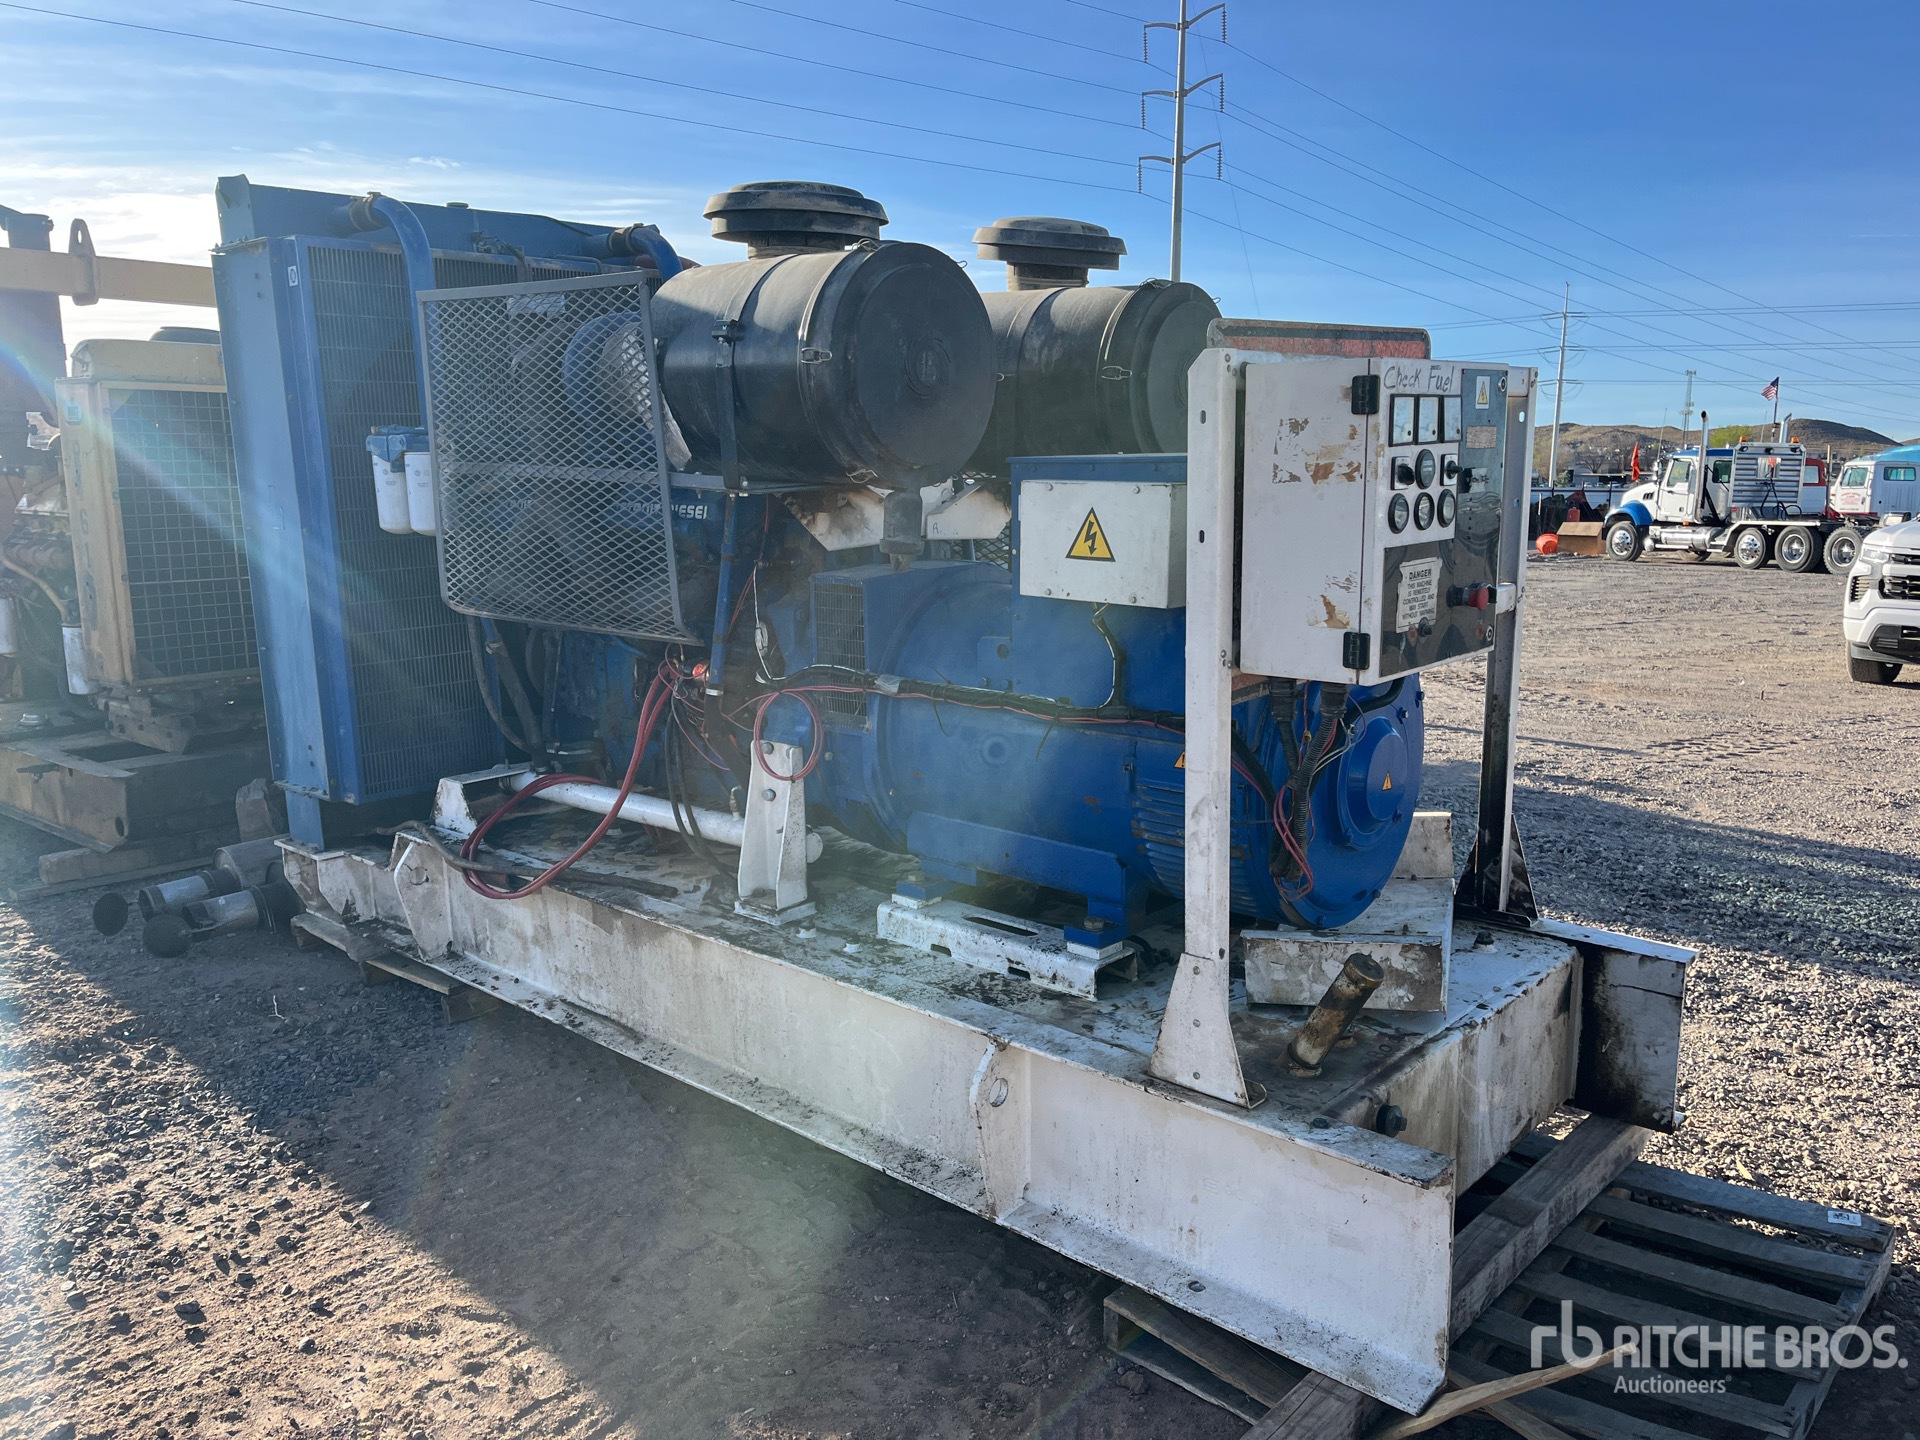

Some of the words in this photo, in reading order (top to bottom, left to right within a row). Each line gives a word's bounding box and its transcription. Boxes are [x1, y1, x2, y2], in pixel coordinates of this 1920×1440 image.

[1383, 365, 1421, 388] Check
[1427, 365, 1455, 392] Fuel
[1409, 569, 1432, 579] DANGER
[1416, 580, 1432, 588] MACHINE
[1413, 587, 1431, 596] REMOTELY
[1402, 595, 1426, 605] CONTROLLED
[1402, 611, 1418, 620] WITHOUT
[1419, 608, 1435, 616] WARNING
